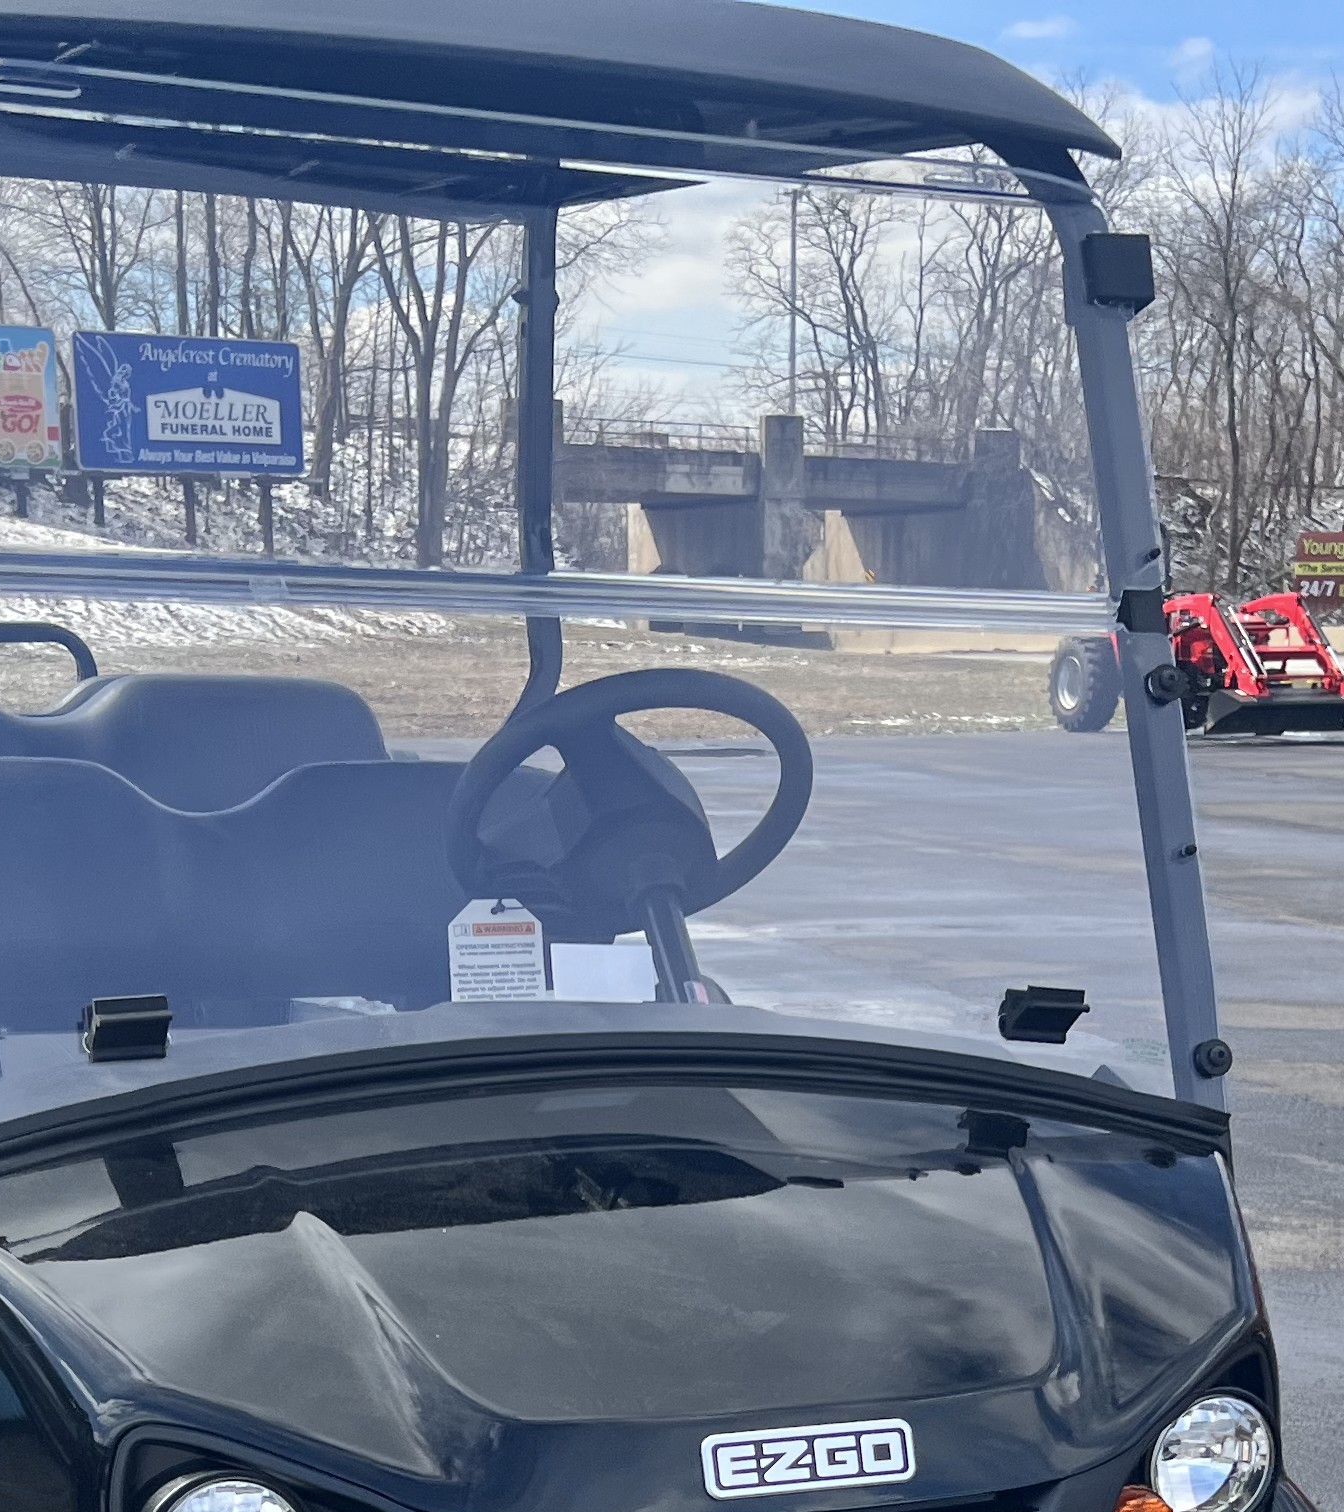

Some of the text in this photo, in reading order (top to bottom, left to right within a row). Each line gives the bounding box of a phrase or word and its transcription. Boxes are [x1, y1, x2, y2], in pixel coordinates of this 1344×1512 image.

[139, 340, 294, 377] Angelcrest Crematory
[207, 370, 218, 382] at
[154, 400, 273, 424] MOELLER
[1, 413, 40, 433] GO!
[161, 422, 273, 438] FUNERAL HOME
[138, 448, 172, 464] Always
[173, 449, 193, 463] Your
[195, 450, 216, 463] Best
[216, 450, 241, 464] Value
[1300, 580, 1336, 597] 24/7
